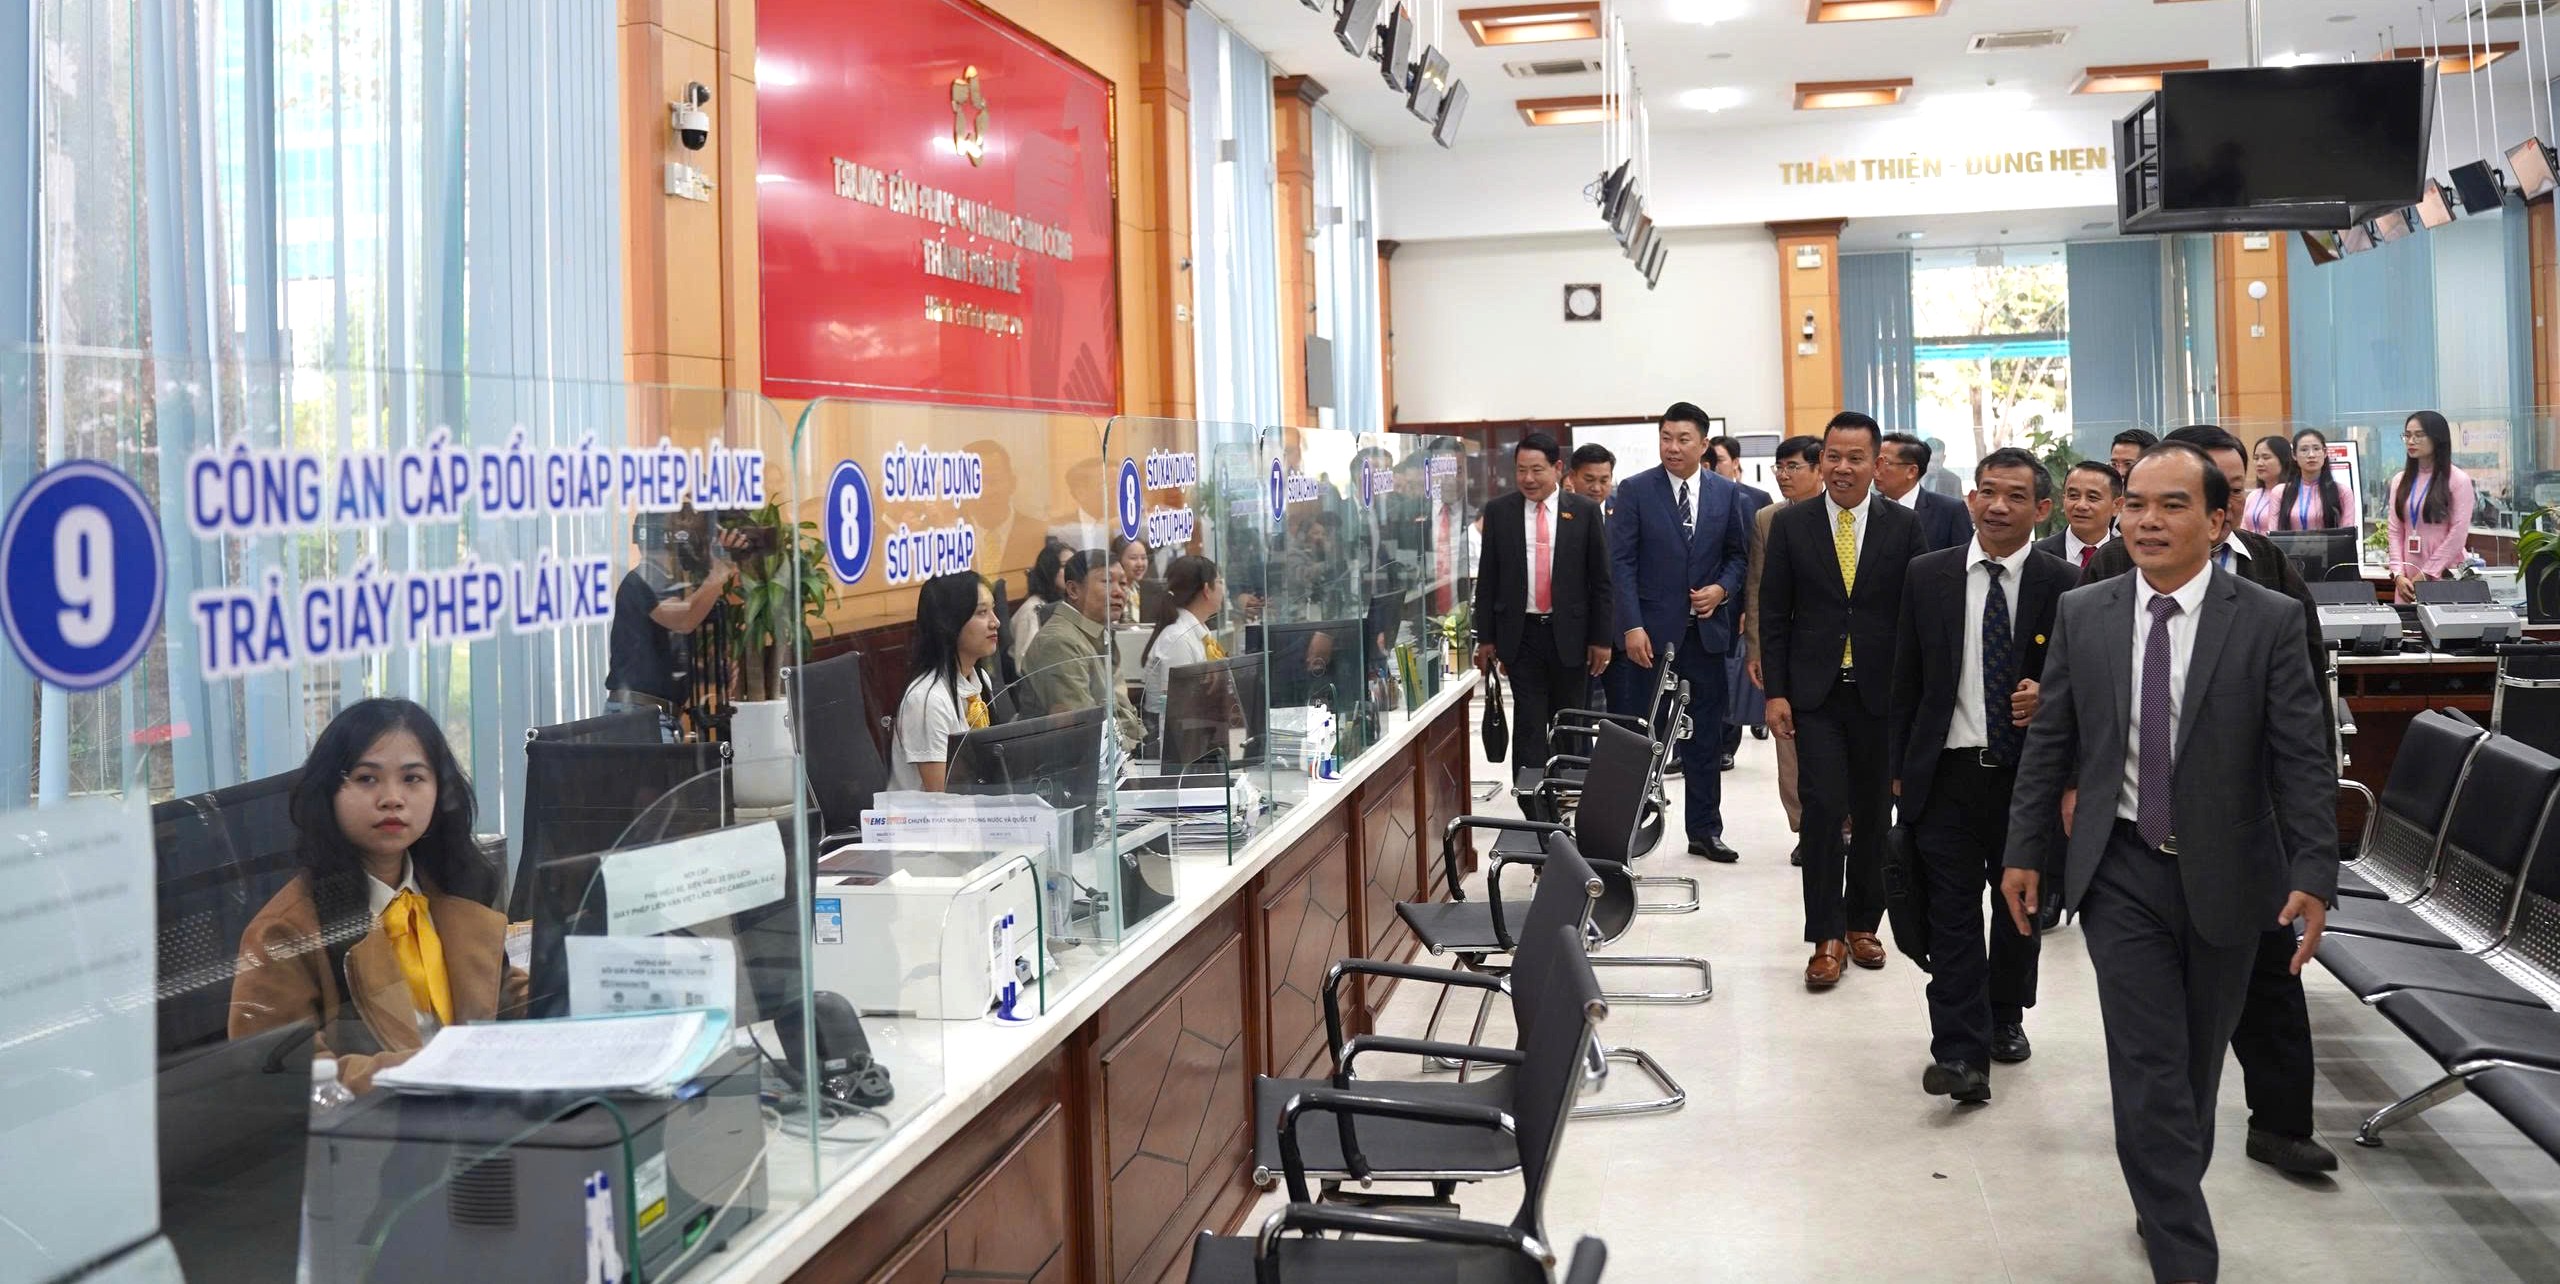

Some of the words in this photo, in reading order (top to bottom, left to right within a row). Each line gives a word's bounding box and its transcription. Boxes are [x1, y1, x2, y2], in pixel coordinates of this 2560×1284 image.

[194, 443, 320, 528] CÔNG
[336, 457, 386, 522] AN
[401, 434, 470, 517] CẤP
[481, 432, 537, 512] ĐỔI
[621, 441, 688, 506] PHÉP
[694, 442, 730, 503] LÁI
[735, 456, 763, 503] XE
[885, 446, 907, 497] SỞ
[911, 450, 938, 497] XÂY
[943, 456, 981, 504] DỰNG
[1126, 474, 1136, 526] 8
[840, 484, 860, 561] 8
[888, 526, 909, 580] SỞ
[913, 532, 933, 575] TƯ
[937, 524, 974, 572] PHÁP
[53, 504, 115, 649] 9
[198, 573, 290, 670] TRẢ
[305, 562, 395, 655] GIẤY
[408, 561, 503, 641] PHÉP
[515, 556, 562, 625] LÁI
[573, 561, 609, 617] XE
[870, 818, 886, 826] EMS
